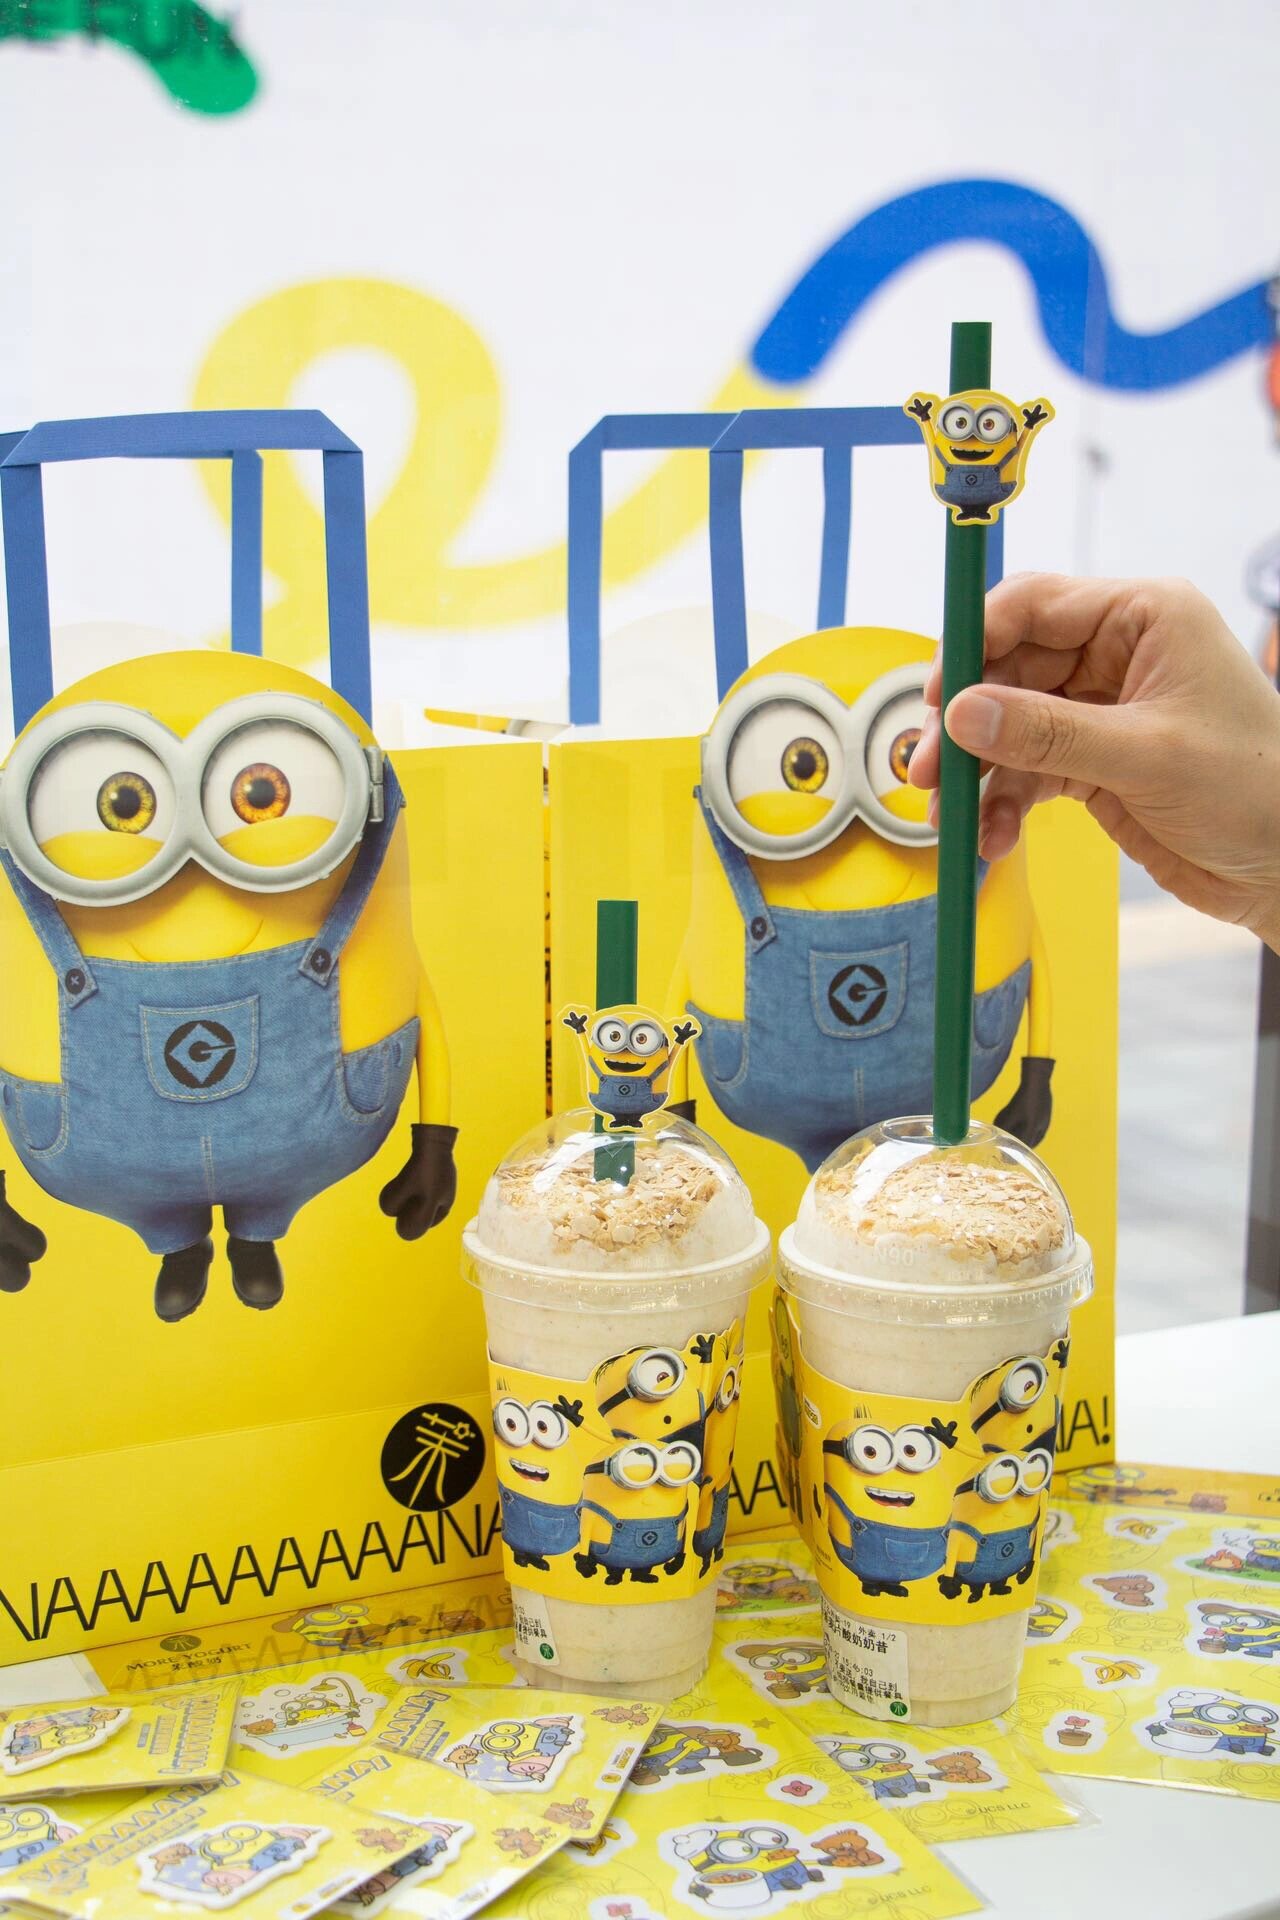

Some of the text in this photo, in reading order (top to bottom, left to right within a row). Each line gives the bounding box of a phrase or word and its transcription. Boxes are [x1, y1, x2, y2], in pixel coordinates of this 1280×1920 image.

[881, 1632, 896, 1642] 1/2
[126, 1642, 253, 1672] MORE YOGURT
